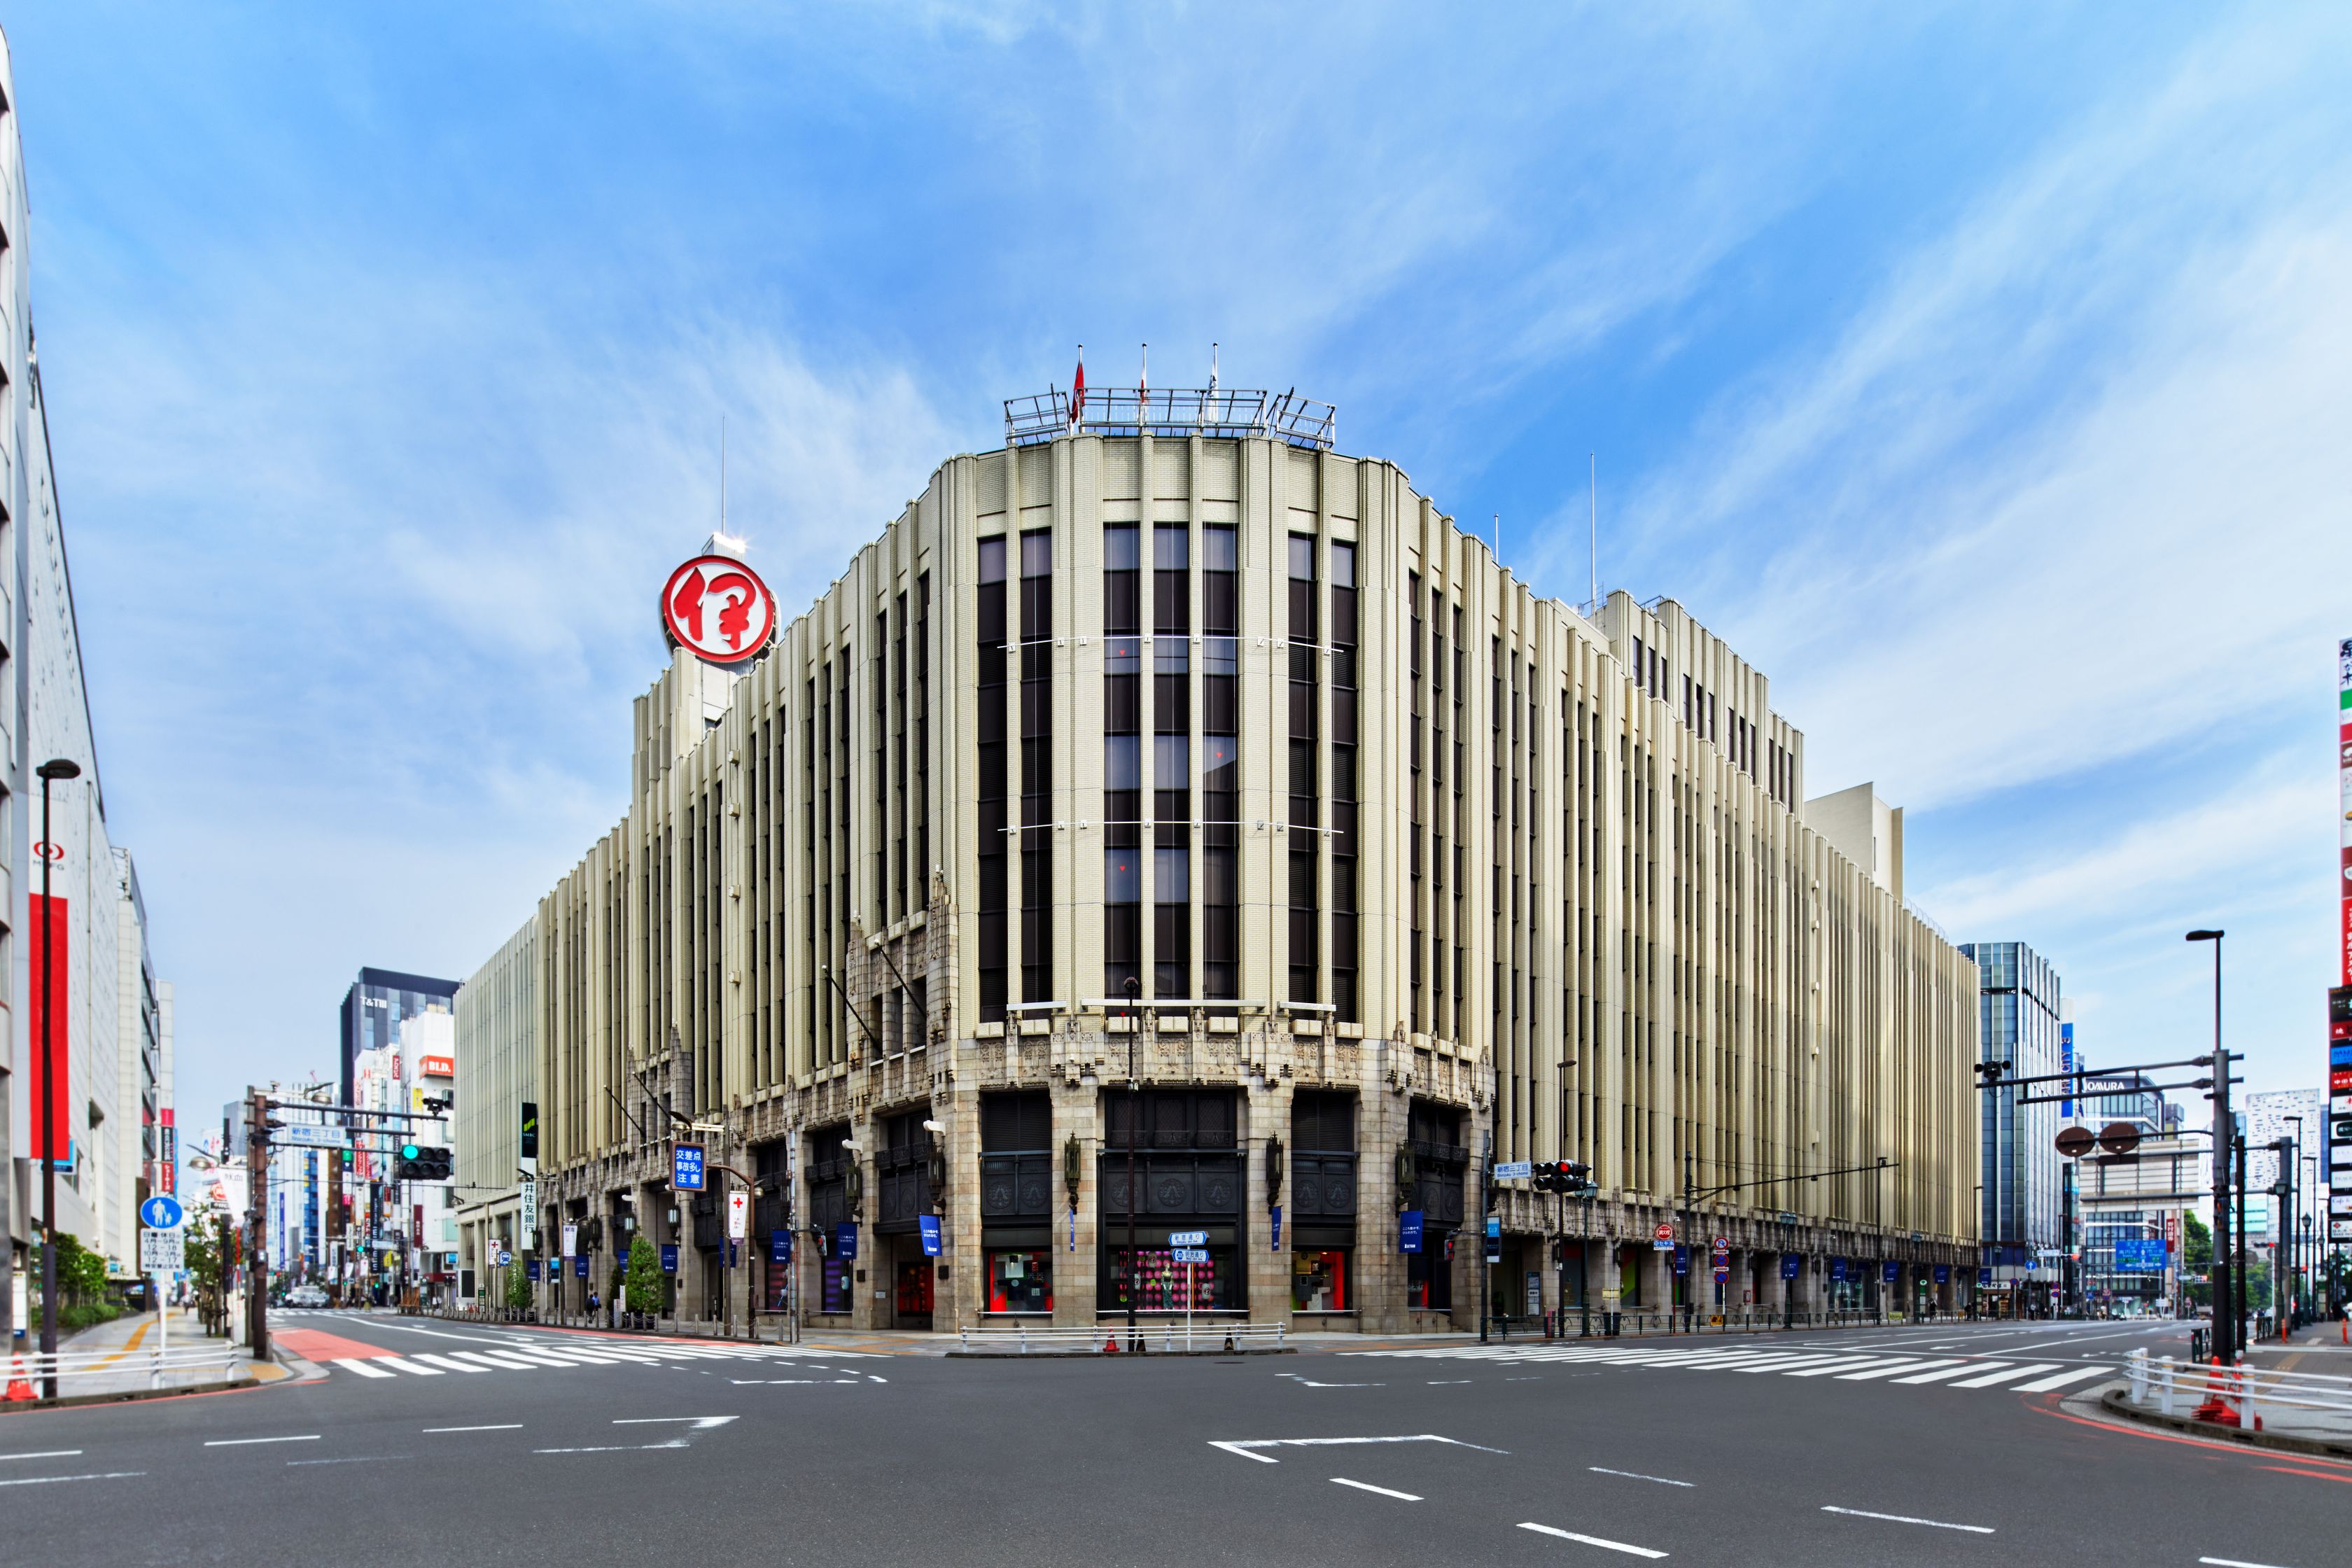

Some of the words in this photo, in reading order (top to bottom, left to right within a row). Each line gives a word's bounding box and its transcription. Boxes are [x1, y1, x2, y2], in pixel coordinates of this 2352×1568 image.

[33, 860, 64, 871] MFG
[428, 1060, 451, 1073] BLD.
[291, 1127, 340, 1138] 新宿三丁目
[676, 1149, 701, 1161] 交差点
[676, 1161, 701, 1172] 事故多し
[1497, 1163, 1528, 1173] 新宿三丁目
[677, 1172, 700, 1184] 注意
[524, 1174, 536, 1233] 井住友銀行
